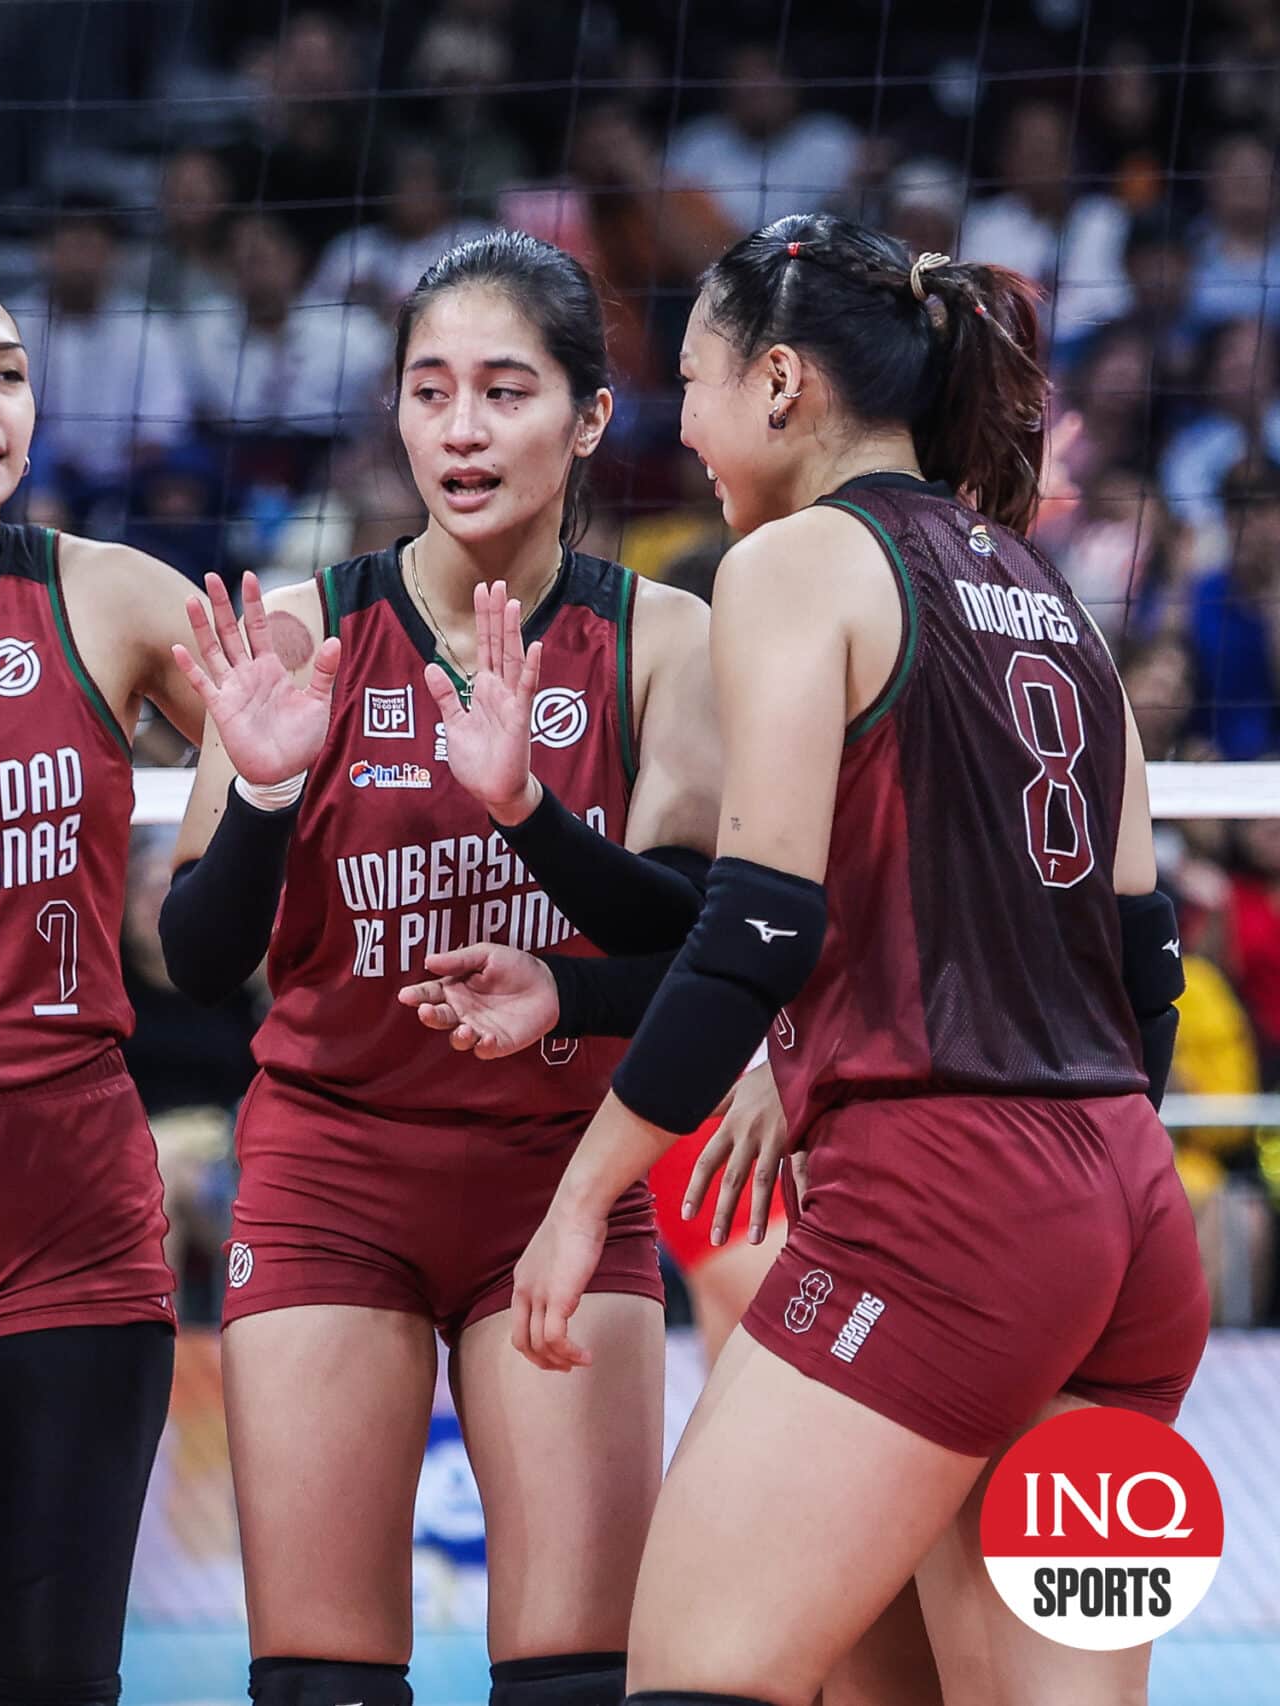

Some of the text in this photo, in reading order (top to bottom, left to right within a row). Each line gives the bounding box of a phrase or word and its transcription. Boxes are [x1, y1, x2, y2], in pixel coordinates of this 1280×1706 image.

[372, 709, 407, 730] UP
[375, 763, 430, 783] InLife
[1006, 651, 1095, 888] 8
[784, 1269, 833, 1334] 8
